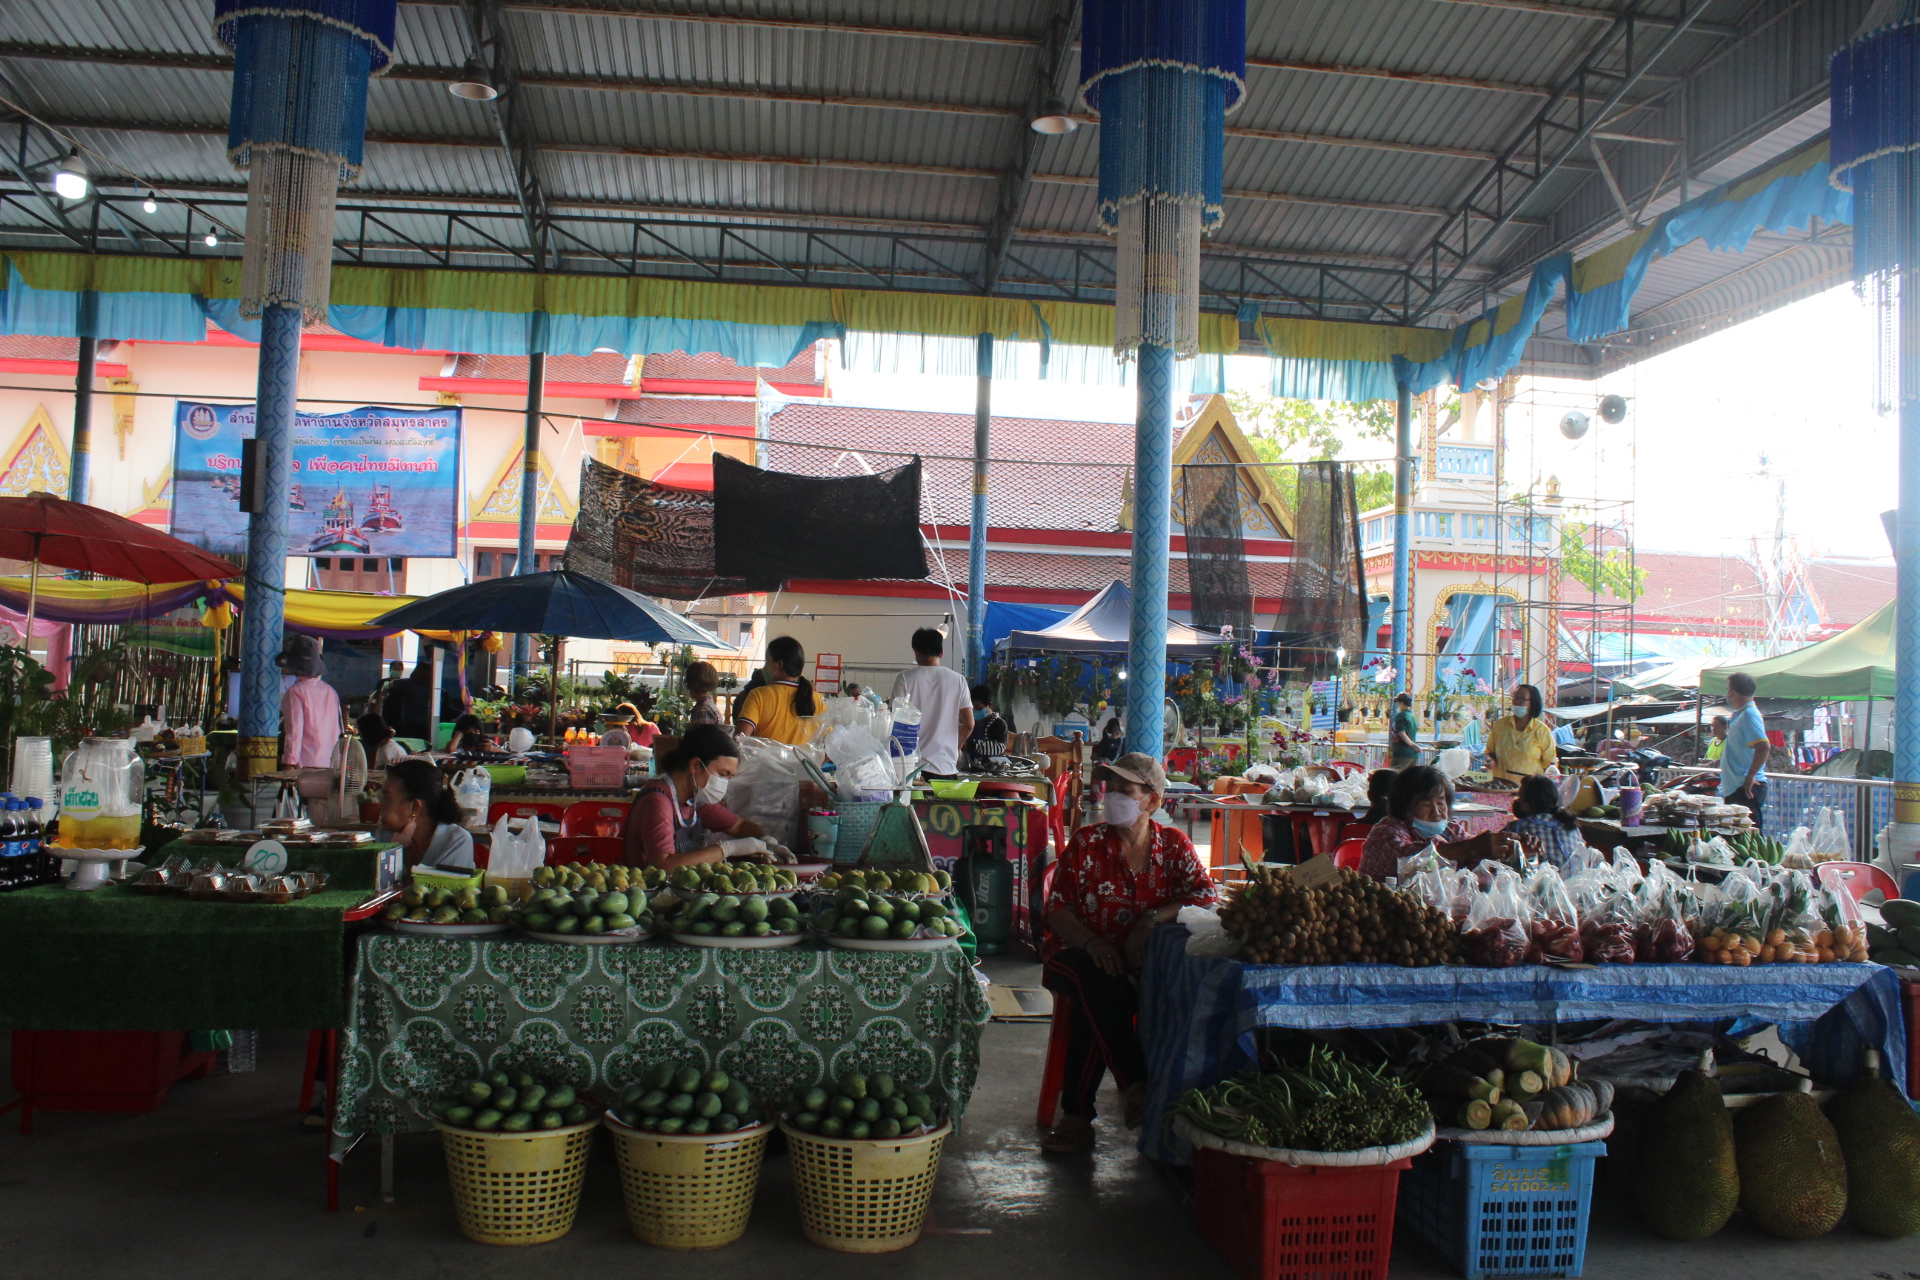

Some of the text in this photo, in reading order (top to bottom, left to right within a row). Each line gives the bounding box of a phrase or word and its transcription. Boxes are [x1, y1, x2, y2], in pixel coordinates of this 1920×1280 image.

[309, 454, 439, 473] เพื่อคนไทยมีงานทำ
[248, 849, 280, 871] 20
[1490, 1180, 1571, 1193] 54100229
